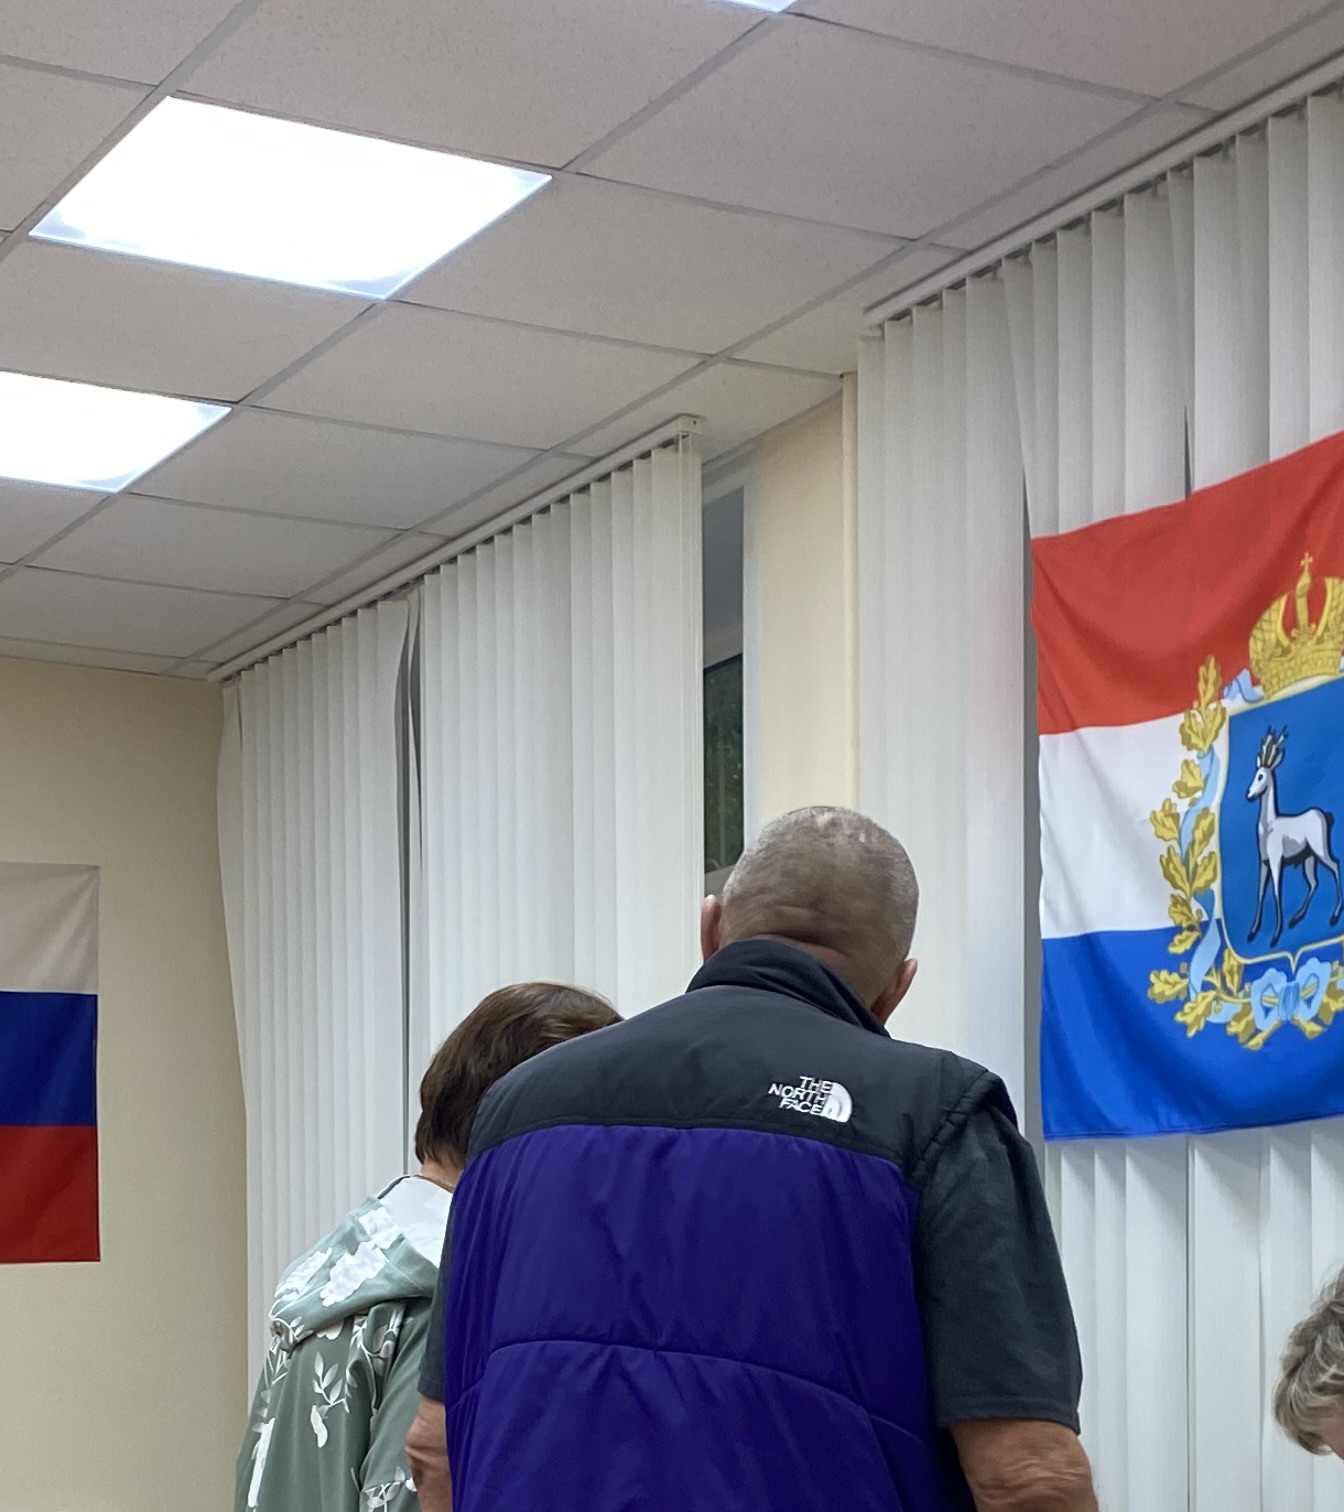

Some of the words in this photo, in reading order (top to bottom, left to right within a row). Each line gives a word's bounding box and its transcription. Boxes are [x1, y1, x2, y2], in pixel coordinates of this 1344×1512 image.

[768, 1083, 828, 1106] NORTH
[799, 1075, 833, 1095] THE
[779, 1097, 823, 1116] FACE
